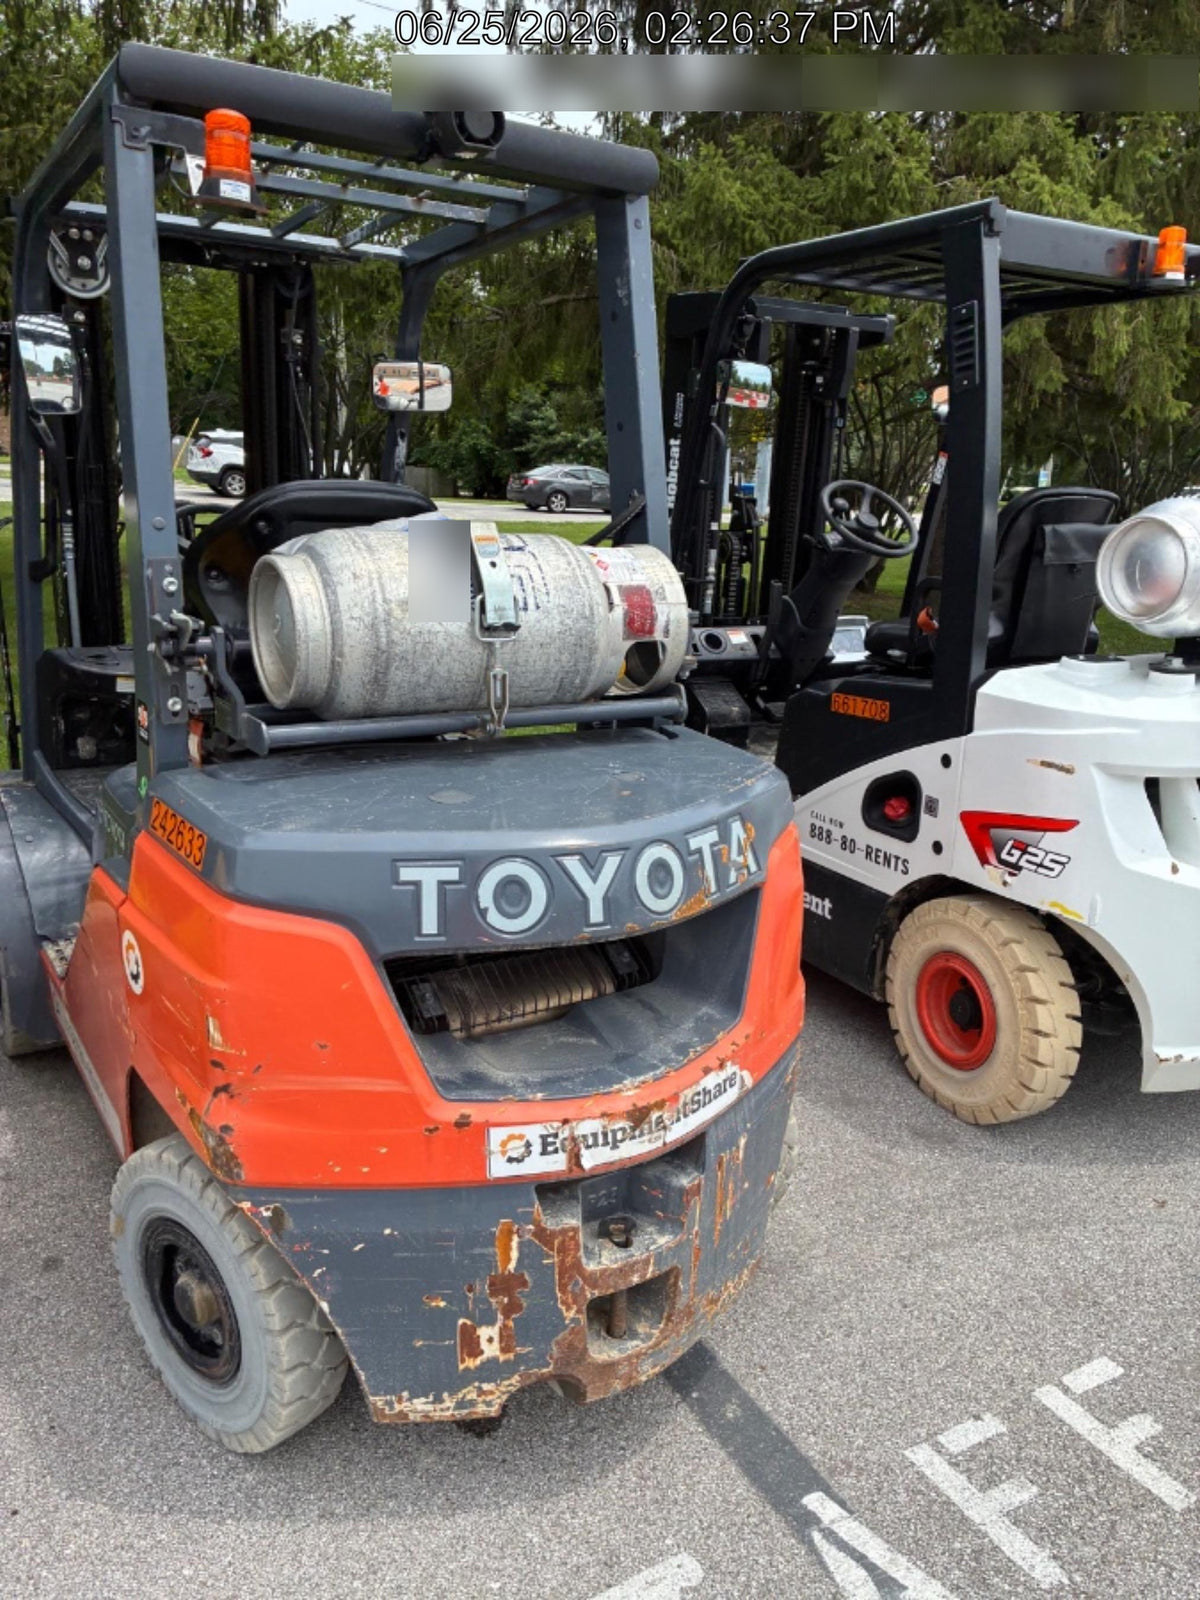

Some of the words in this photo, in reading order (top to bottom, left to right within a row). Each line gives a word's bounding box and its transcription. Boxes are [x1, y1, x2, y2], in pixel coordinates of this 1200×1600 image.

[832, 694, 888, 720] 661708
[150, 800, 205, 866] 242633
[810, 810, 826, 823] CALL
[829, 817, 845, 829] NOW
[809, 823, 910, 875] 888-80-RENTS
[1000, 837, 1071, 879] G25
[398, 814, 760, 936] TOYOTA
